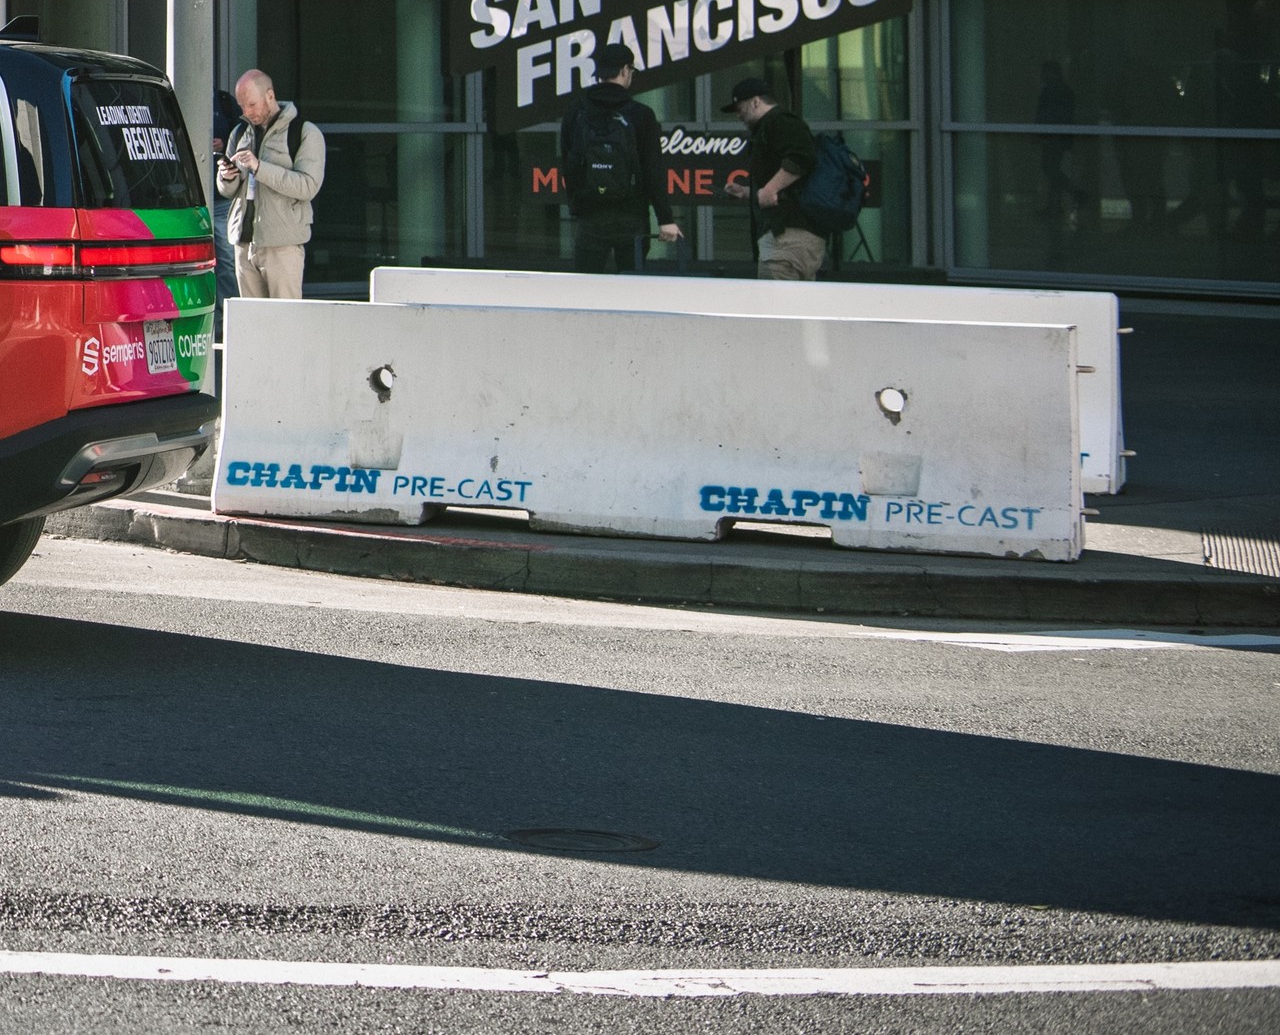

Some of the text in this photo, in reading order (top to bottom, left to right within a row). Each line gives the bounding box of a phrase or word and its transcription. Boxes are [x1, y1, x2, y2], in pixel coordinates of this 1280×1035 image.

[96, 106, 153, 125] LEADING IDENTITY
[122, 127, 180, 162] RESILIENCE
[660, 129, 747, 155] elcome
[103, 337, 144, 364] semperis
[226, 461, 533, 503] CHAPIN PRE-CAST
[698, 485, 1040, 530] CHAPIN PRE-CAST
